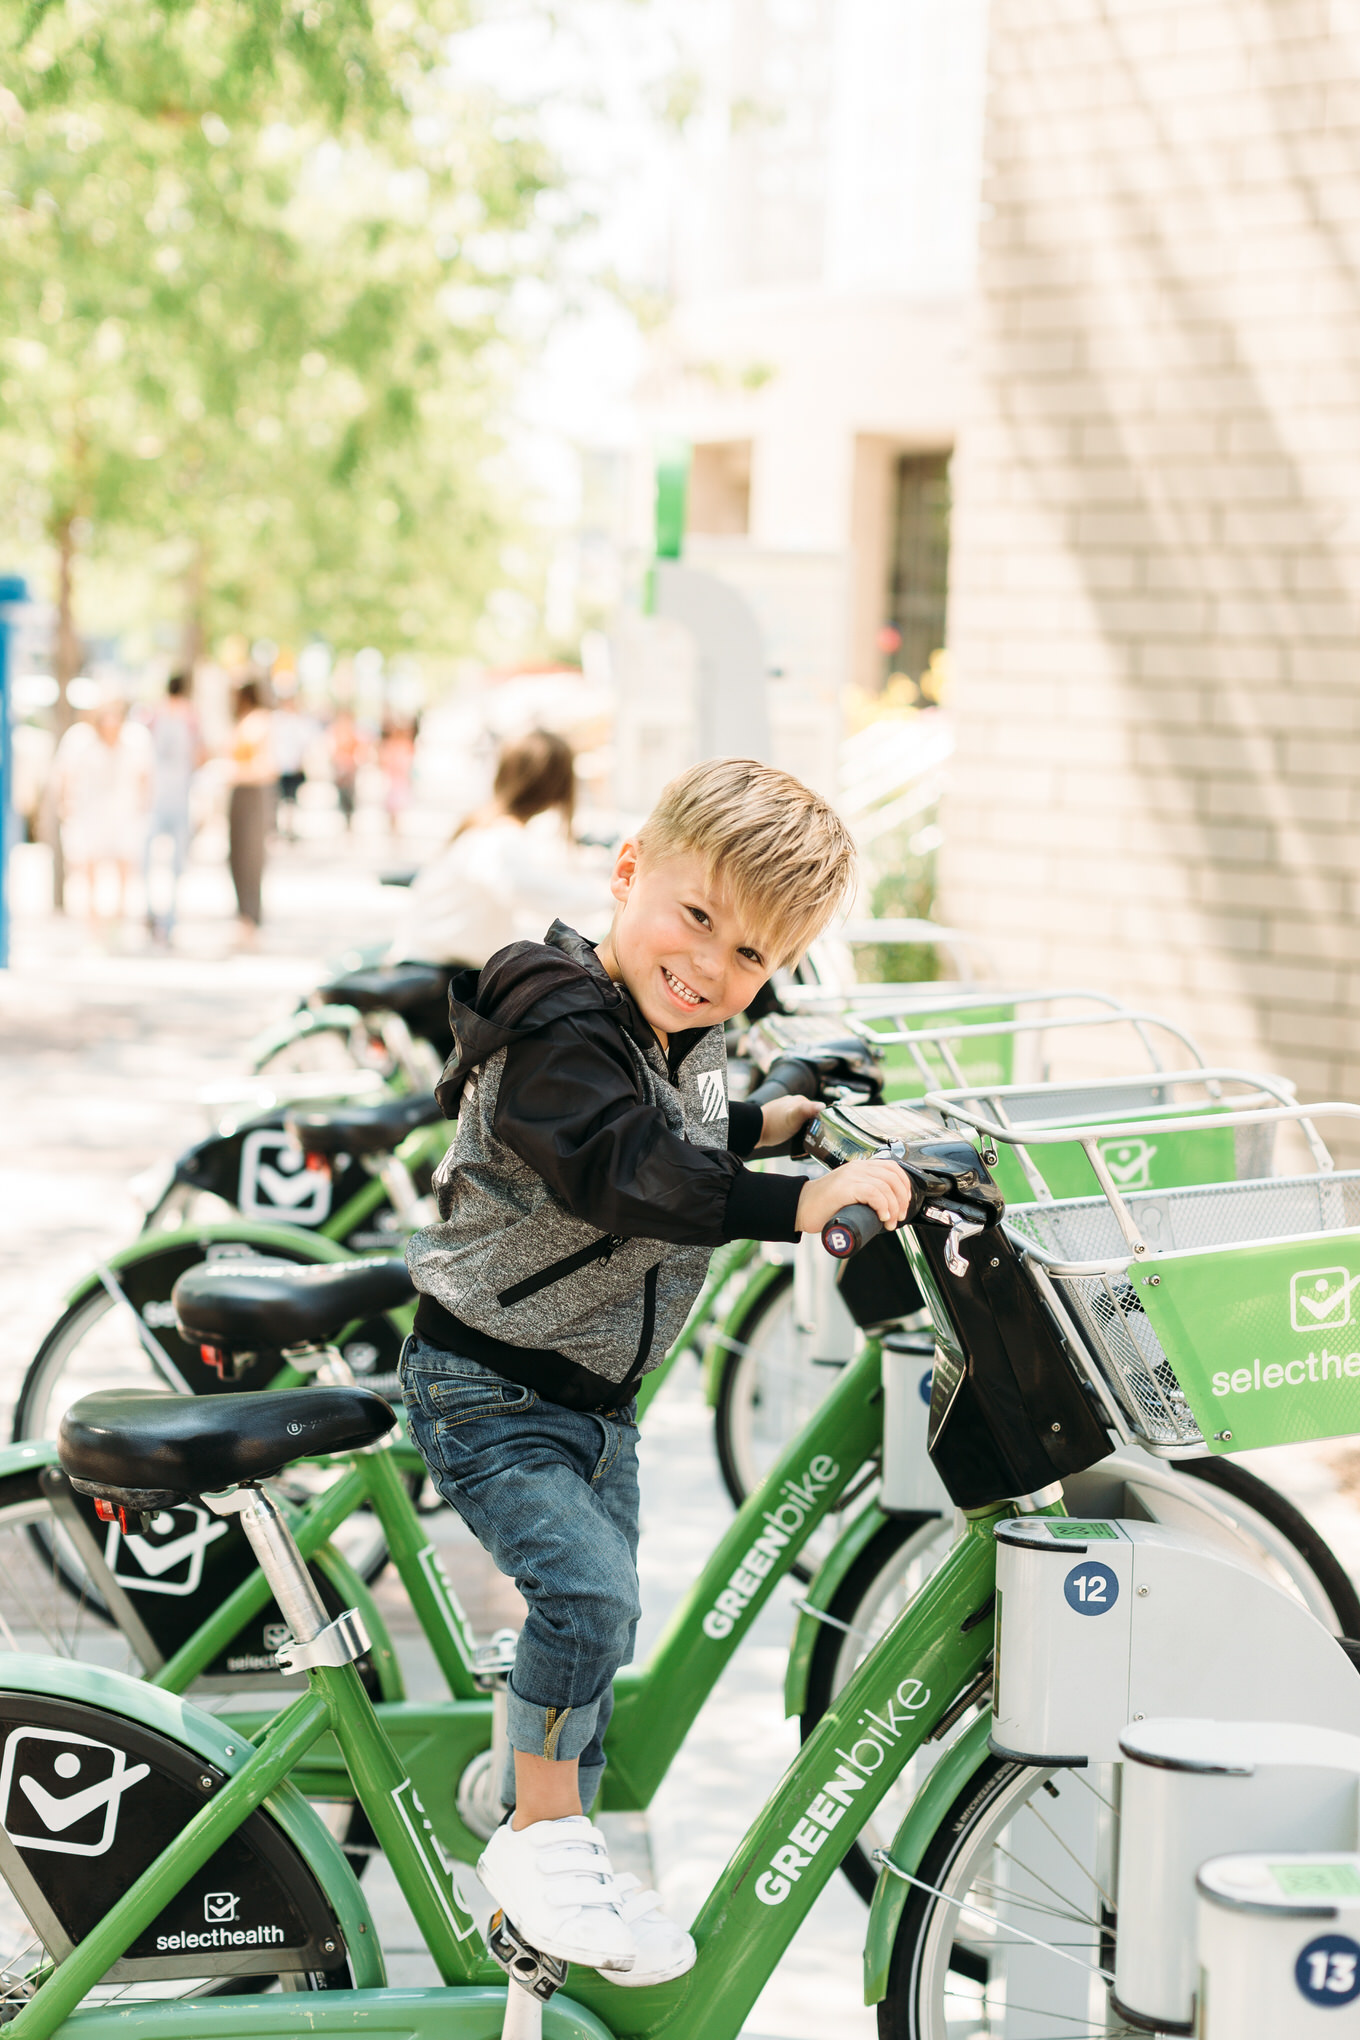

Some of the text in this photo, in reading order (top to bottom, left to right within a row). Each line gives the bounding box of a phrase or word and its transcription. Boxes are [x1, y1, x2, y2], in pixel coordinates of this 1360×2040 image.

[831, 1232, 847, 1250] B
[702, 1454, 840, 1640] GREENbike
[1073, 1575, 1107, 1602] 12
[755, 1678, 931, 1906] GREENbike
[156, 1924, 285, 1951] selecthealth
[1307, 1950, 1358, 1993] 13
